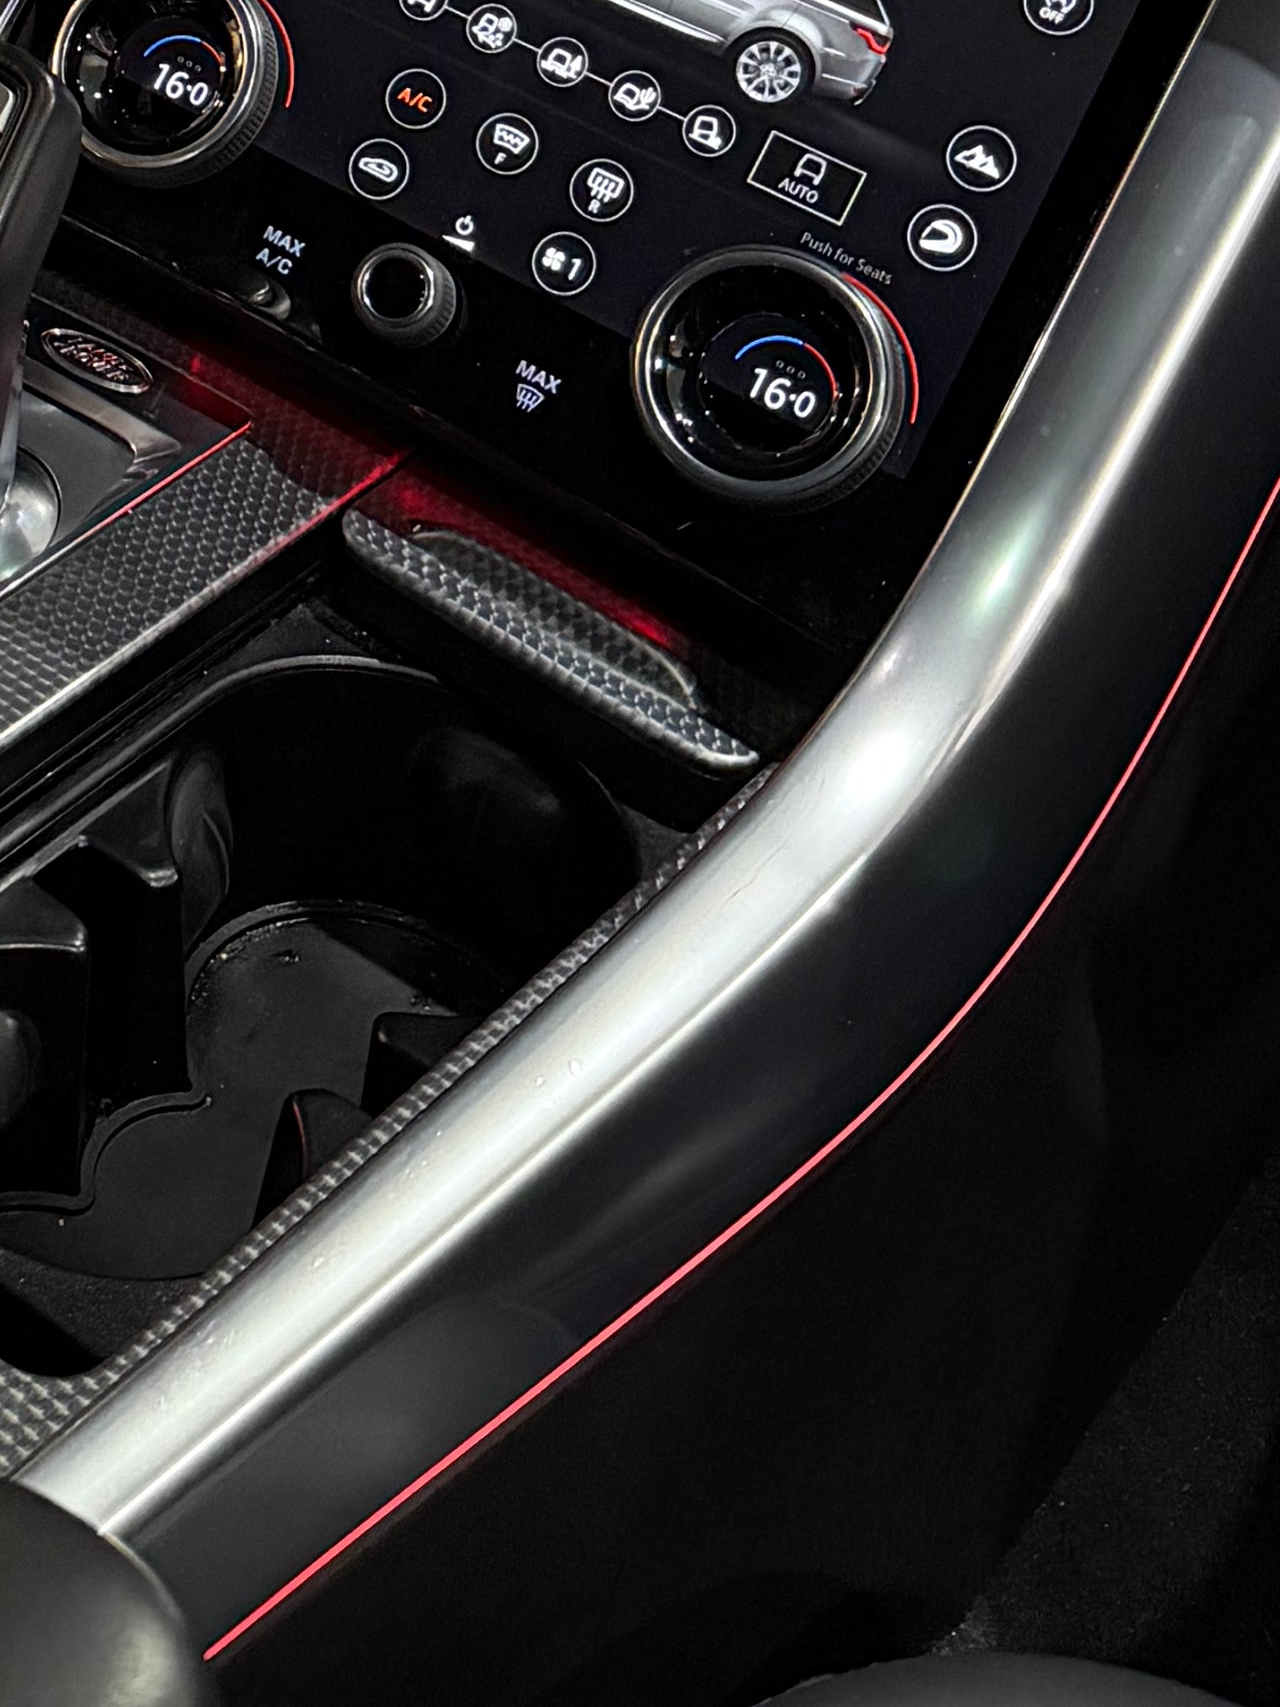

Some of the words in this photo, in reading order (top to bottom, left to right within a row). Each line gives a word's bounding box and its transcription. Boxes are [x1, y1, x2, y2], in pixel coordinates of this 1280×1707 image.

[1038, 5, 1066, 25] OFF
[396, 86, 434, 114] A/C
[493, 151, 508, 165] F
[777, 177, 819, 205] AUTO
[587, 198, 601, 215] R
[262, 224, 307, 258] MAX
[254, 247, 294, 276] A/C
[567, 256, 583, 282] 1
[798, 230, 834, 260] Push
[833, 247, 856, 267] for
[855, 258, 894, 286] Seats
[514, 358, 563, 395] MAX
